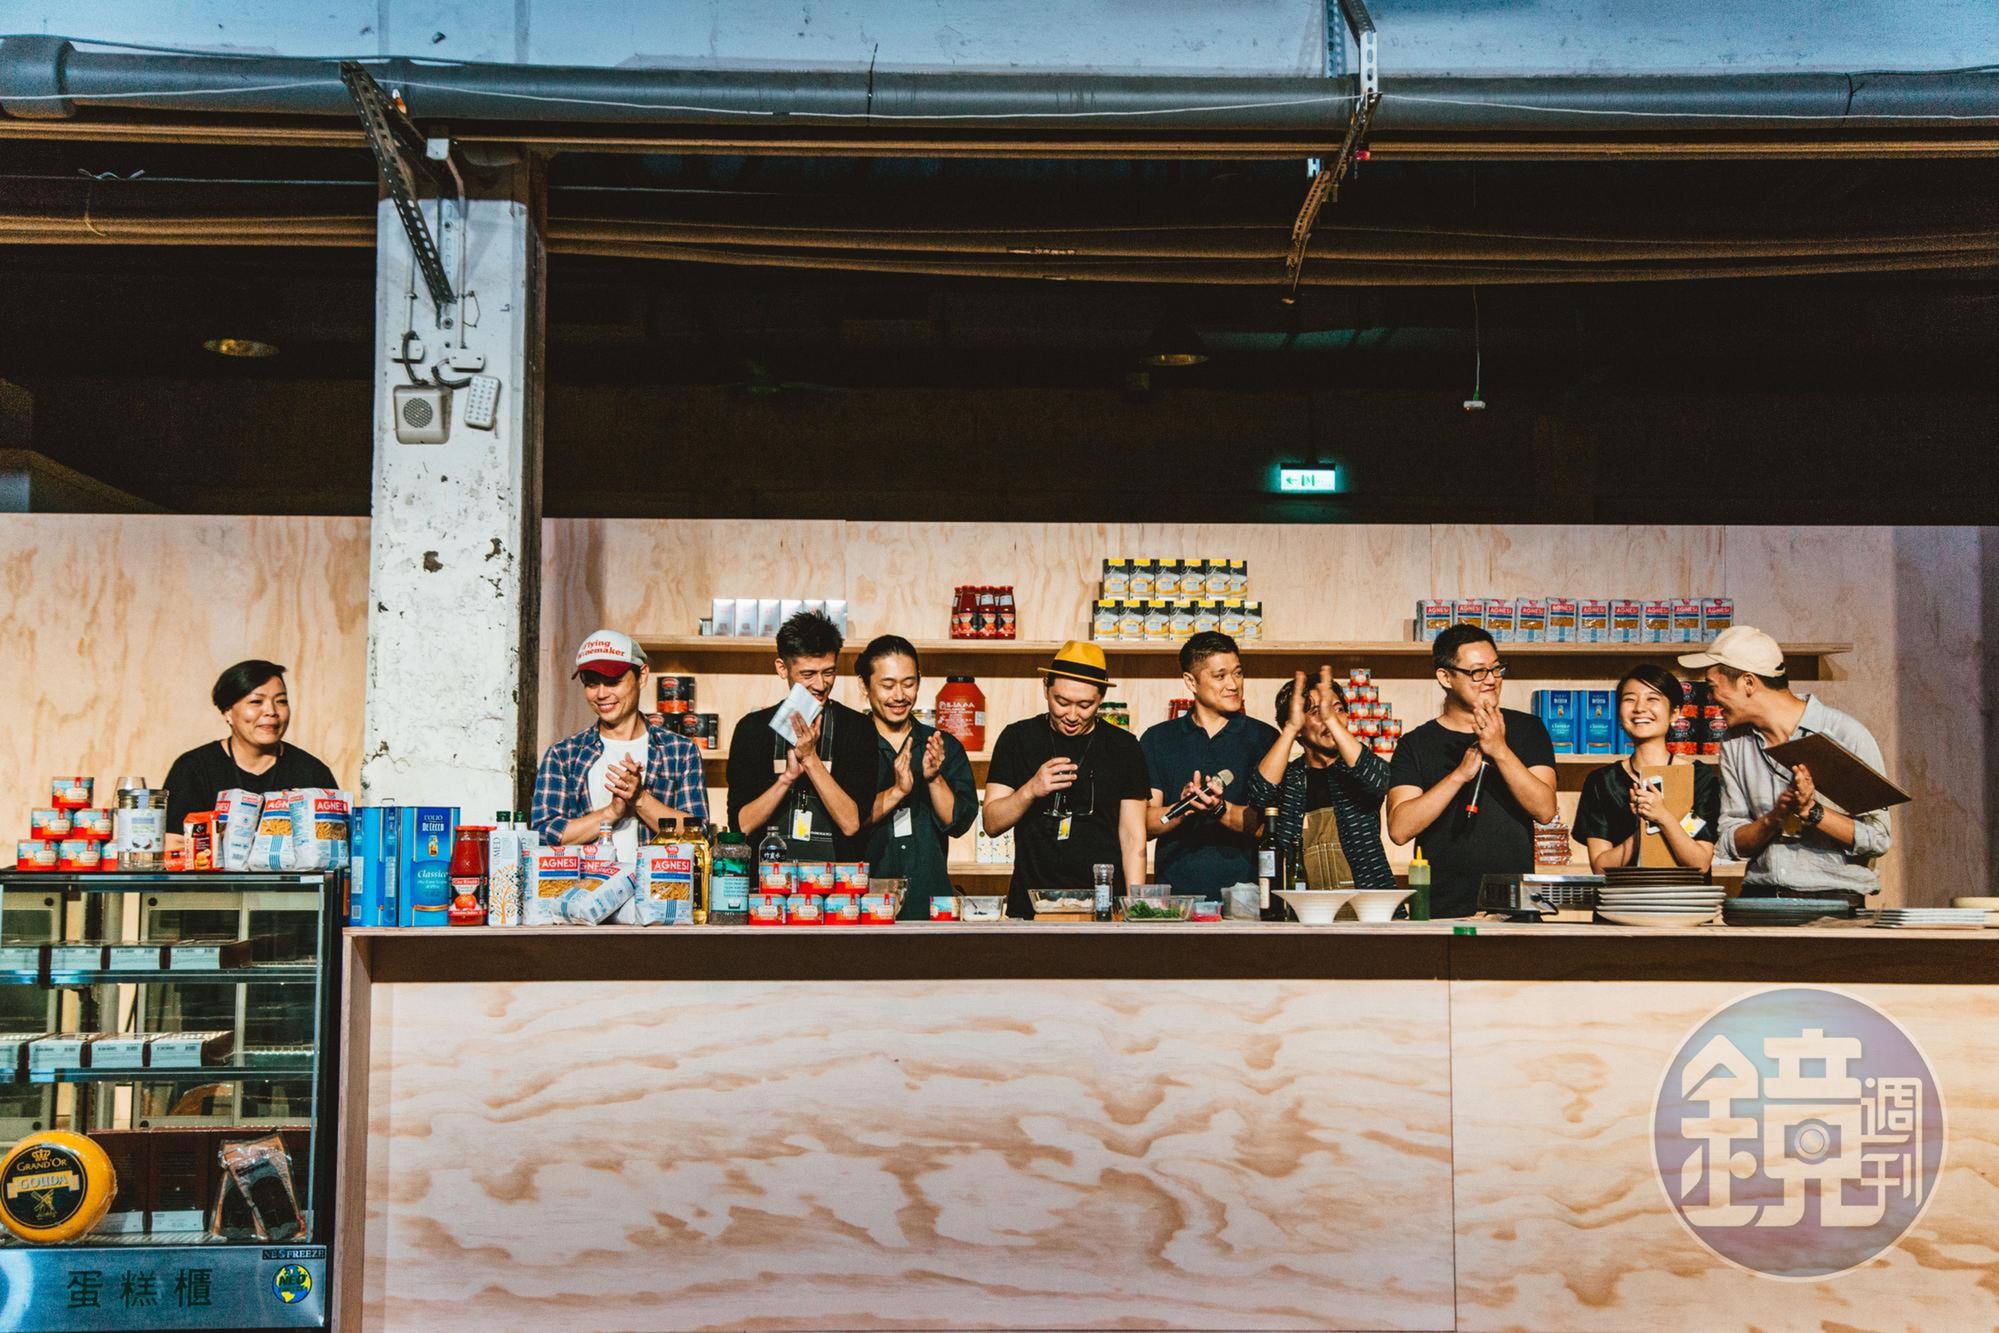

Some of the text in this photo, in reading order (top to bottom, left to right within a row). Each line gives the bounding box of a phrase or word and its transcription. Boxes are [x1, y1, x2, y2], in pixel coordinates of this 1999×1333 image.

[267, 799, 289, 810] AGN
[541, 858, 577, 869] AGNESI
[654, 860, 690, 871] AGNESI
[21, 1175, 67, 1189] GOUDA
[67, 1268, 213, 1308] 蛋糕櫃
